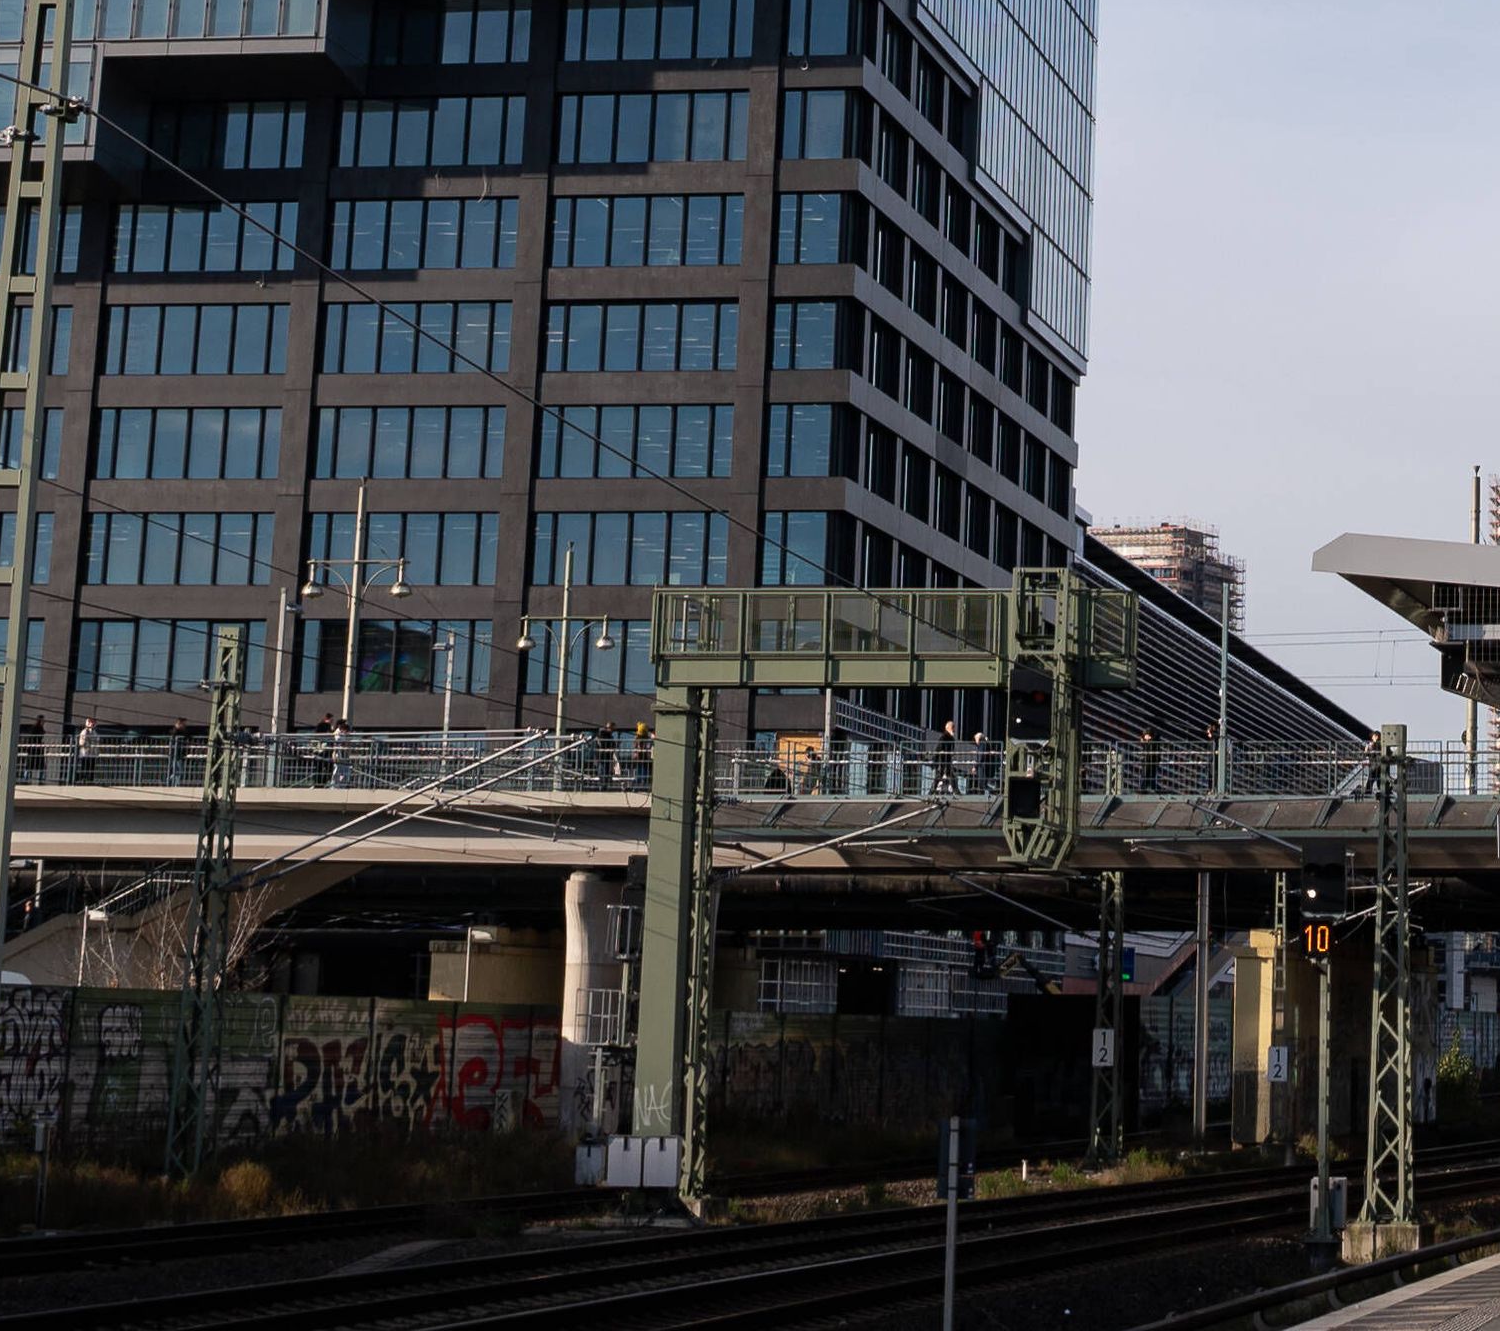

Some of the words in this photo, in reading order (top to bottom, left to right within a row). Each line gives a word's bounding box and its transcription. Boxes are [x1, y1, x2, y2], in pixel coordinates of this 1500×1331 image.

[1304, 924, 1330, 954] 10
[1099, 1047, 1108, 1063] 2
[1274, 1064, 1282, 1078] 2
